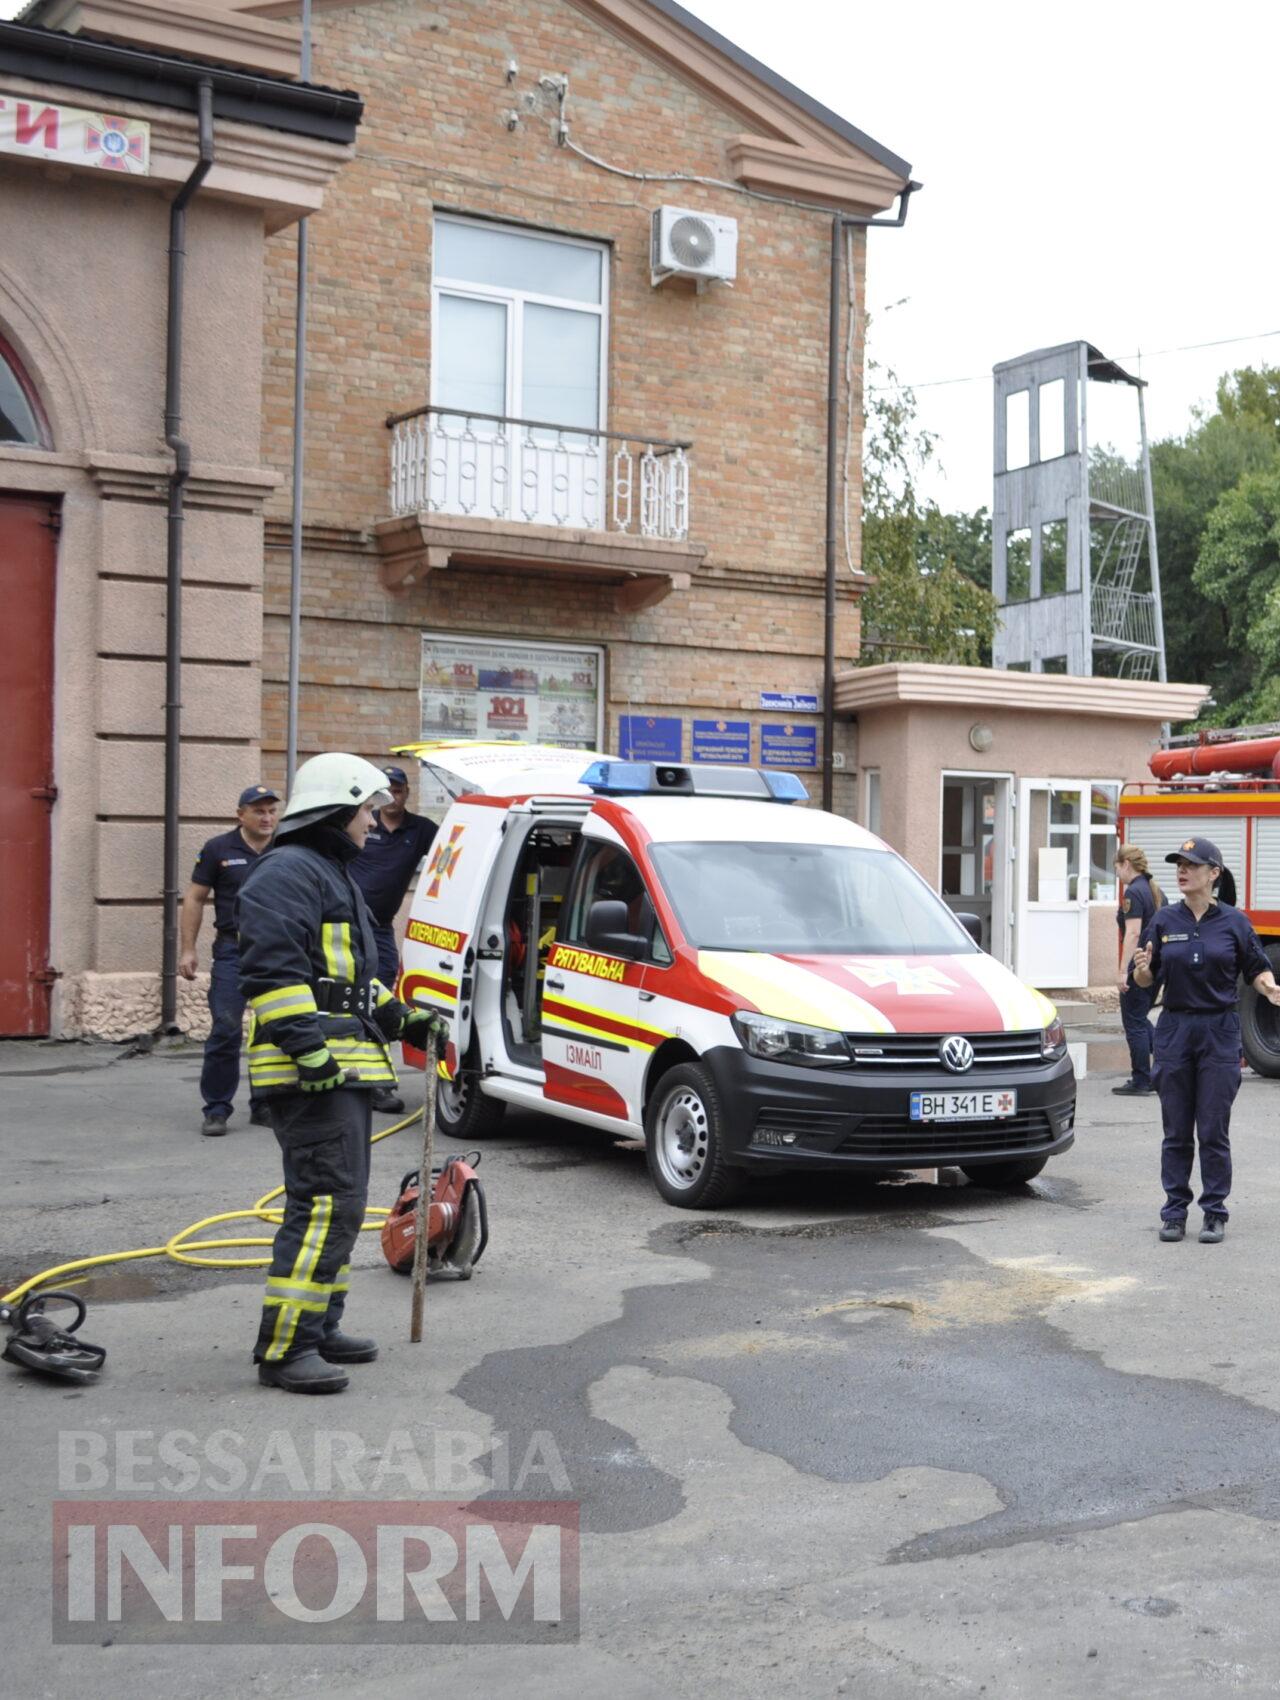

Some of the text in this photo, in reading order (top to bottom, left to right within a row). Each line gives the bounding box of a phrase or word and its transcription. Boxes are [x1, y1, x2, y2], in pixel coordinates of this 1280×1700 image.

[0, 99, 59, 150] И
[489, 696, 527, 715] 101
[408, 920, 460, 951] ОПЕРАТИВНО
[552, 946, 626, 982] РЯТУВАЛЬНА
[566, 1043, 602, 1071] ІЗМАЇЛ
[951, 1095, 977, 1114] 341
